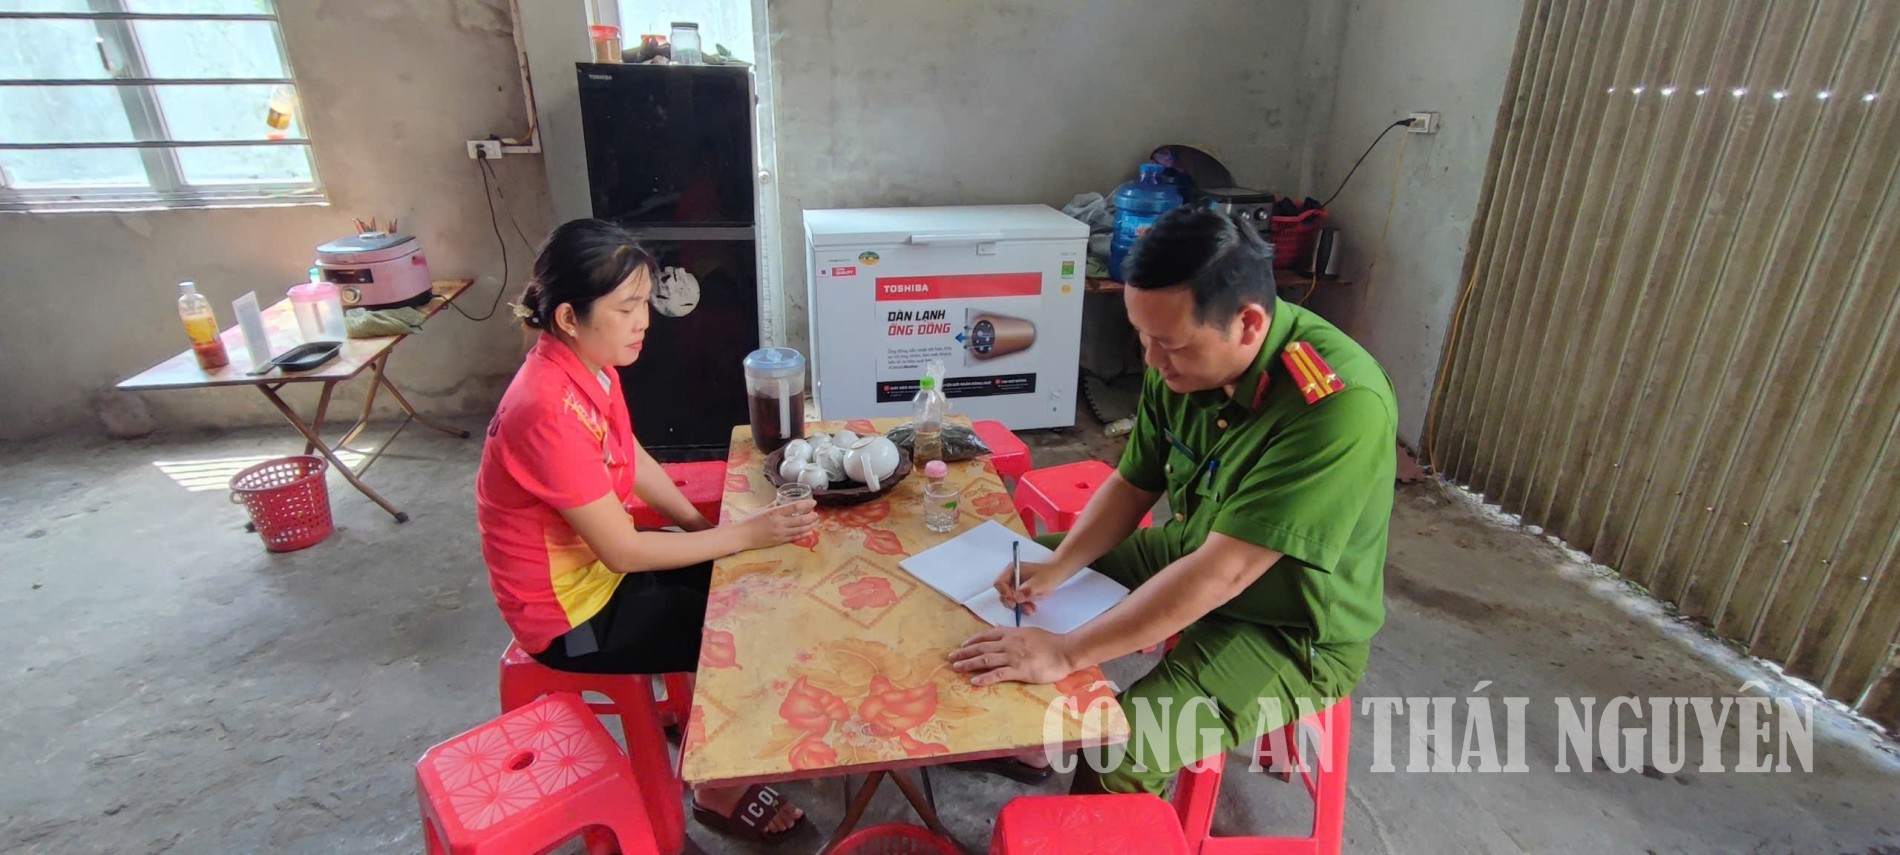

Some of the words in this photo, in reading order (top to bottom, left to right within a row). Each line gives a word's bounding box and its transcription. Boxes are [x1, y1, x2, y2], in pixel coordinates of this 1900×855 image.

[883, 284, 929, 294] TOSHIBA
[888, 309, 912, 322] DÀN
[915, 309, 946, 323] LẠNH
